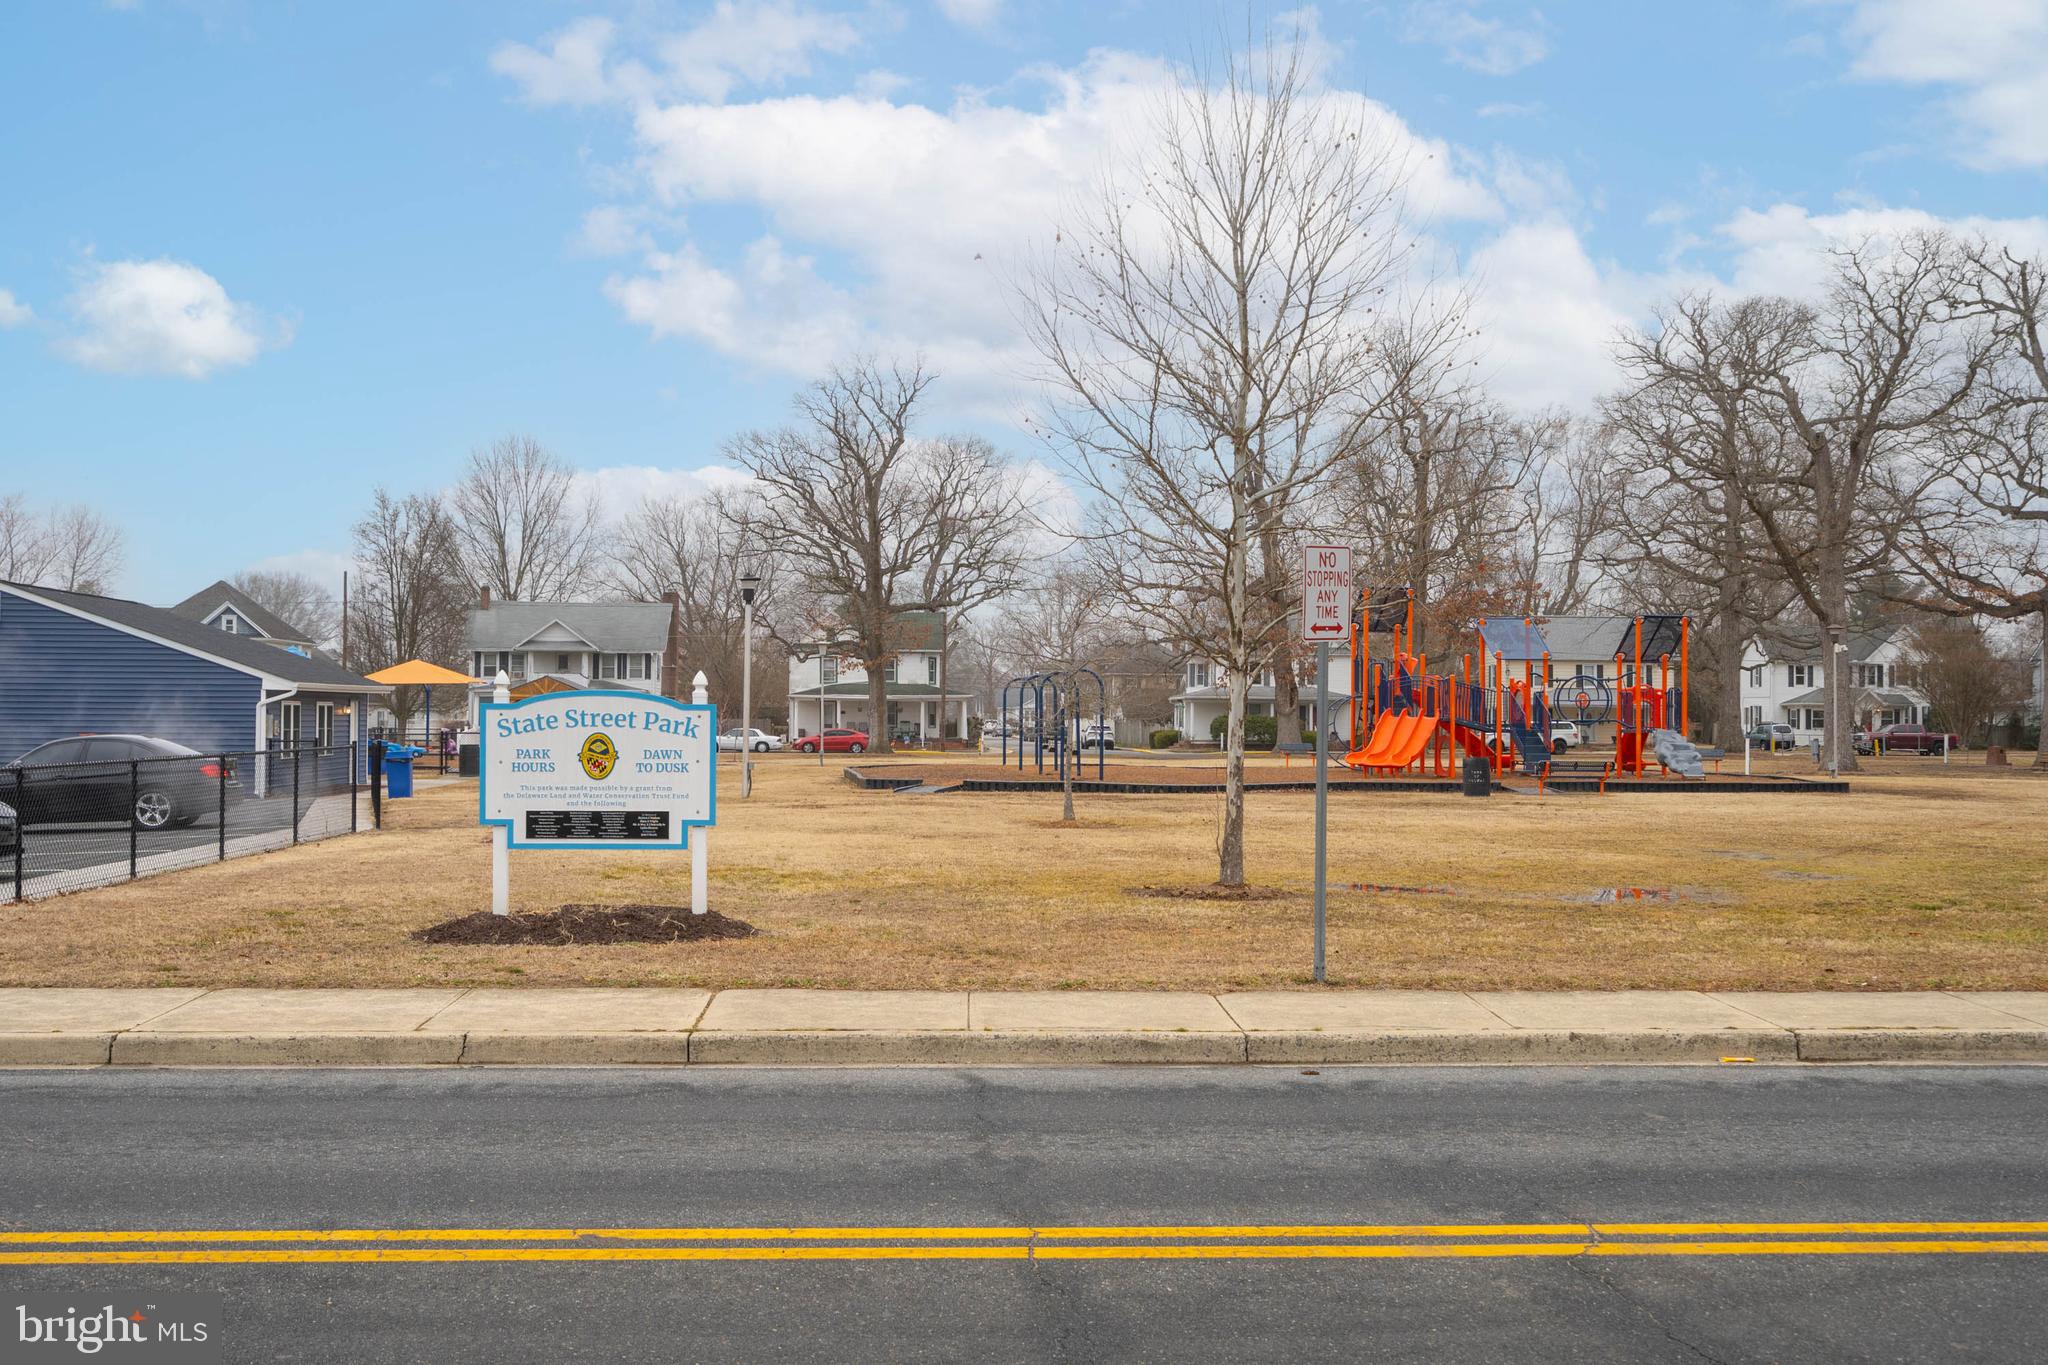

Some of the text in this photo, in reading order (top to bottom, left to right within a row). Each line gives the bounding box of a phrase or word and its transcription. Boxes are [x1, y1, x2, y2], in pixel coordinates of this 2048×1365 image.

[1319, 551, 1337, 568] NO
[1307, 570, 1349, 588] STOPPING
[1316, 590, 1338, 603] ANY
[1316, 605, 1339, 619] TIME
[497, 709, 700, 739] State Street Park
[516, 748, 551, 759] PARK
[643, 749, 682, 760] DAWN
[511, 762, 556, 773] HOURS
[636, 762, 689, 773] TO DUSK
[537, 784, 552, 792] park
[589, 784, 618, 792] possible
[619, 784, 628, 792] by
[594, 800, 627, 808] following
